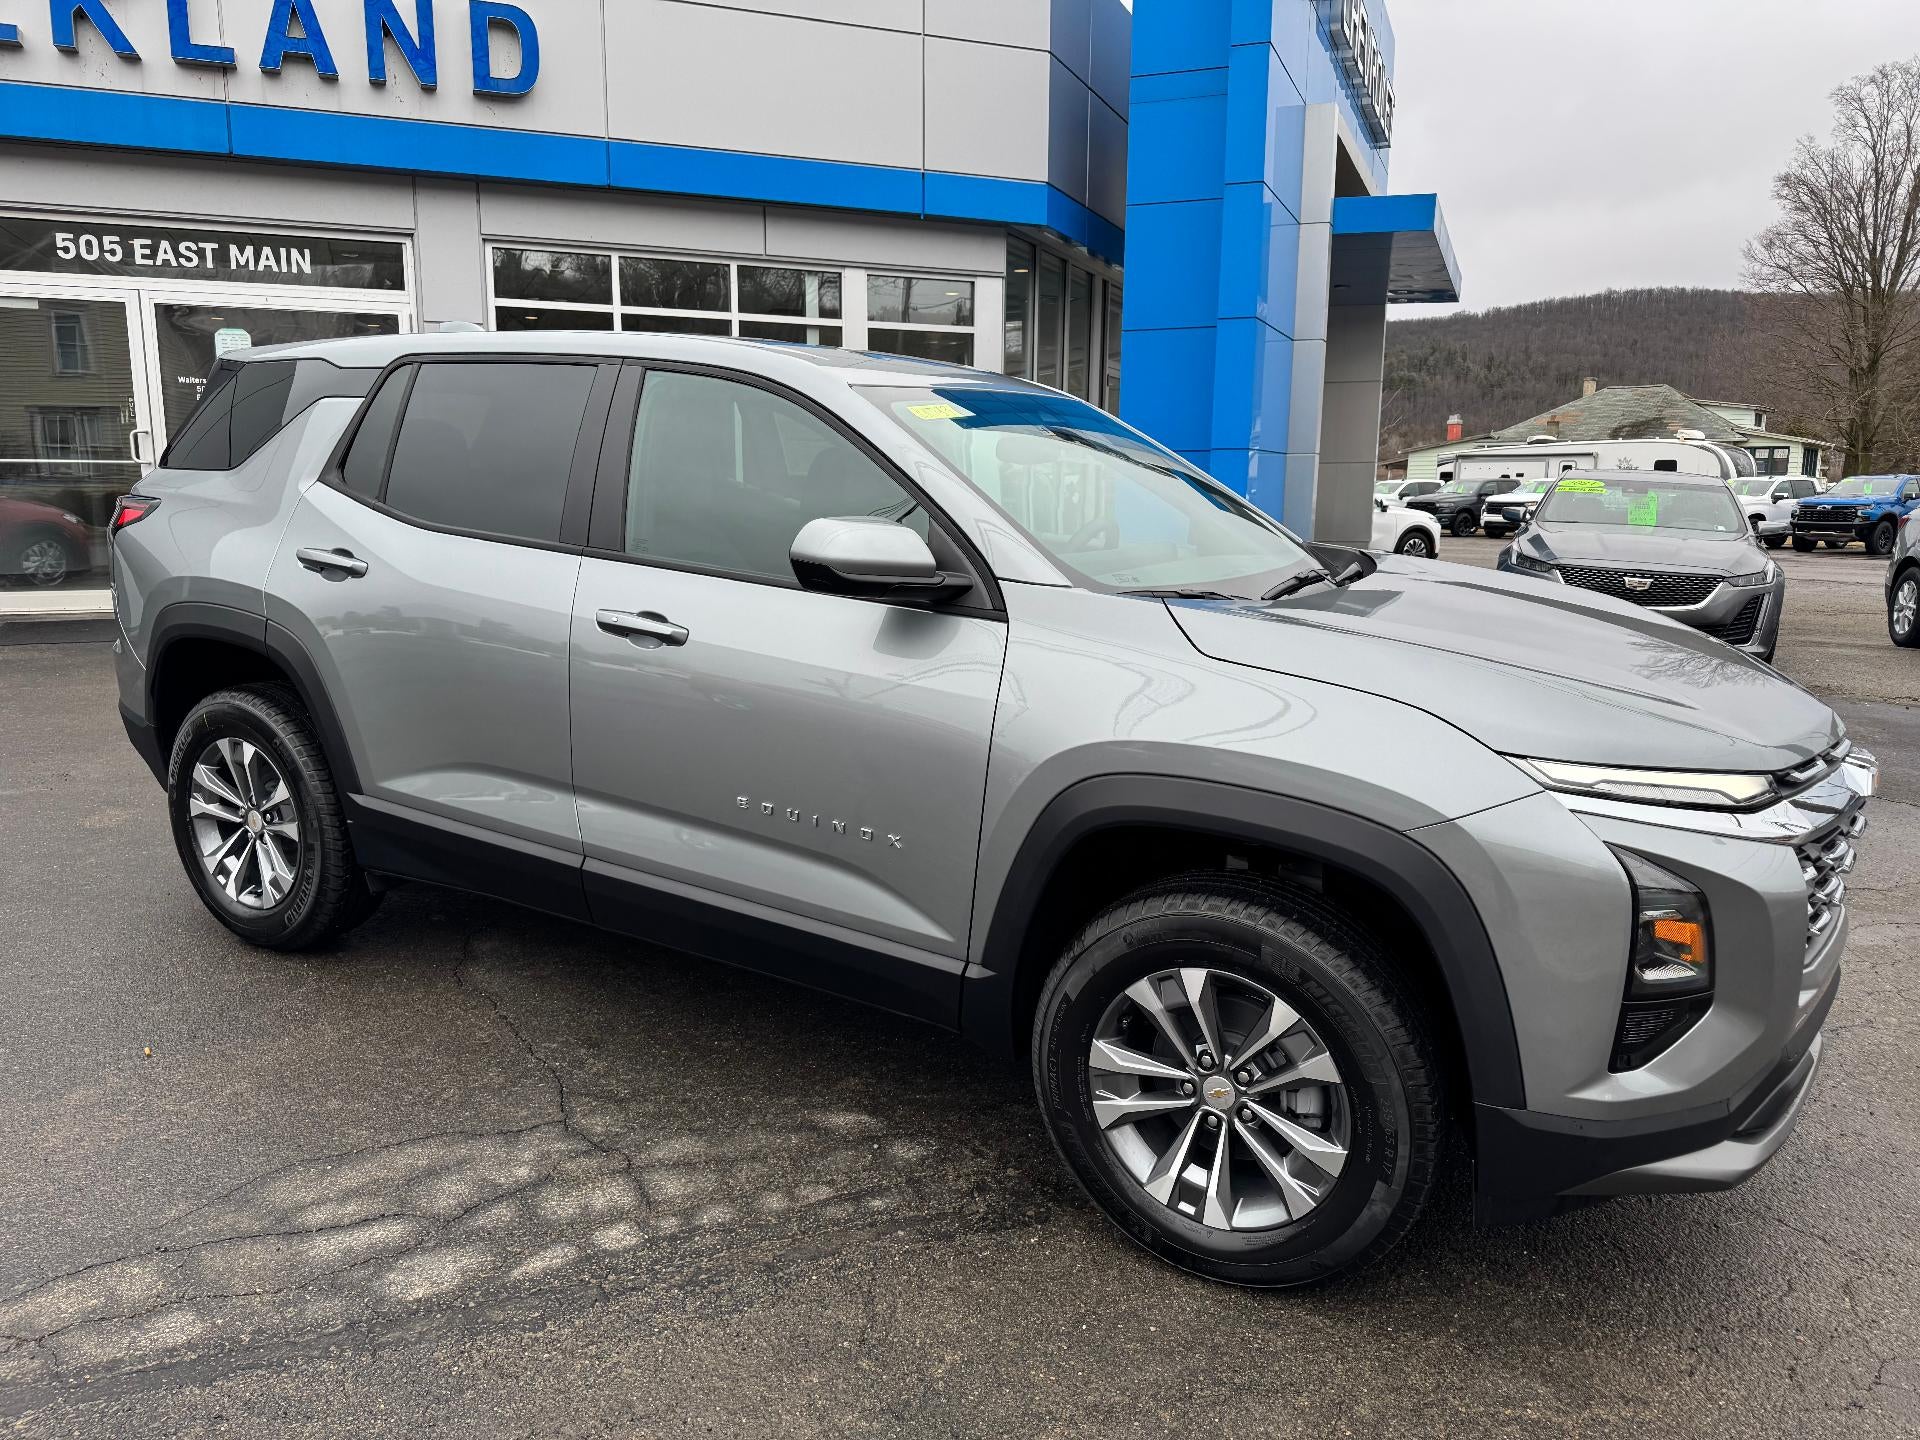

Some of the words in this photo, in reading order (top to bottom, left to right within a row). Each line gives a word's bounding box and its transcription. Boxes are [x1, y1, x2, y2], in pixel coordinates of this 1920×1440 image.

[0, 0, 540, 97] KLAND
[55, 232, 123, 263] 505
[133, 238, 219, 269] EAST
[228, 243, 312, 274] MAIN
[736, 796, 902, 849] EQUINOX
